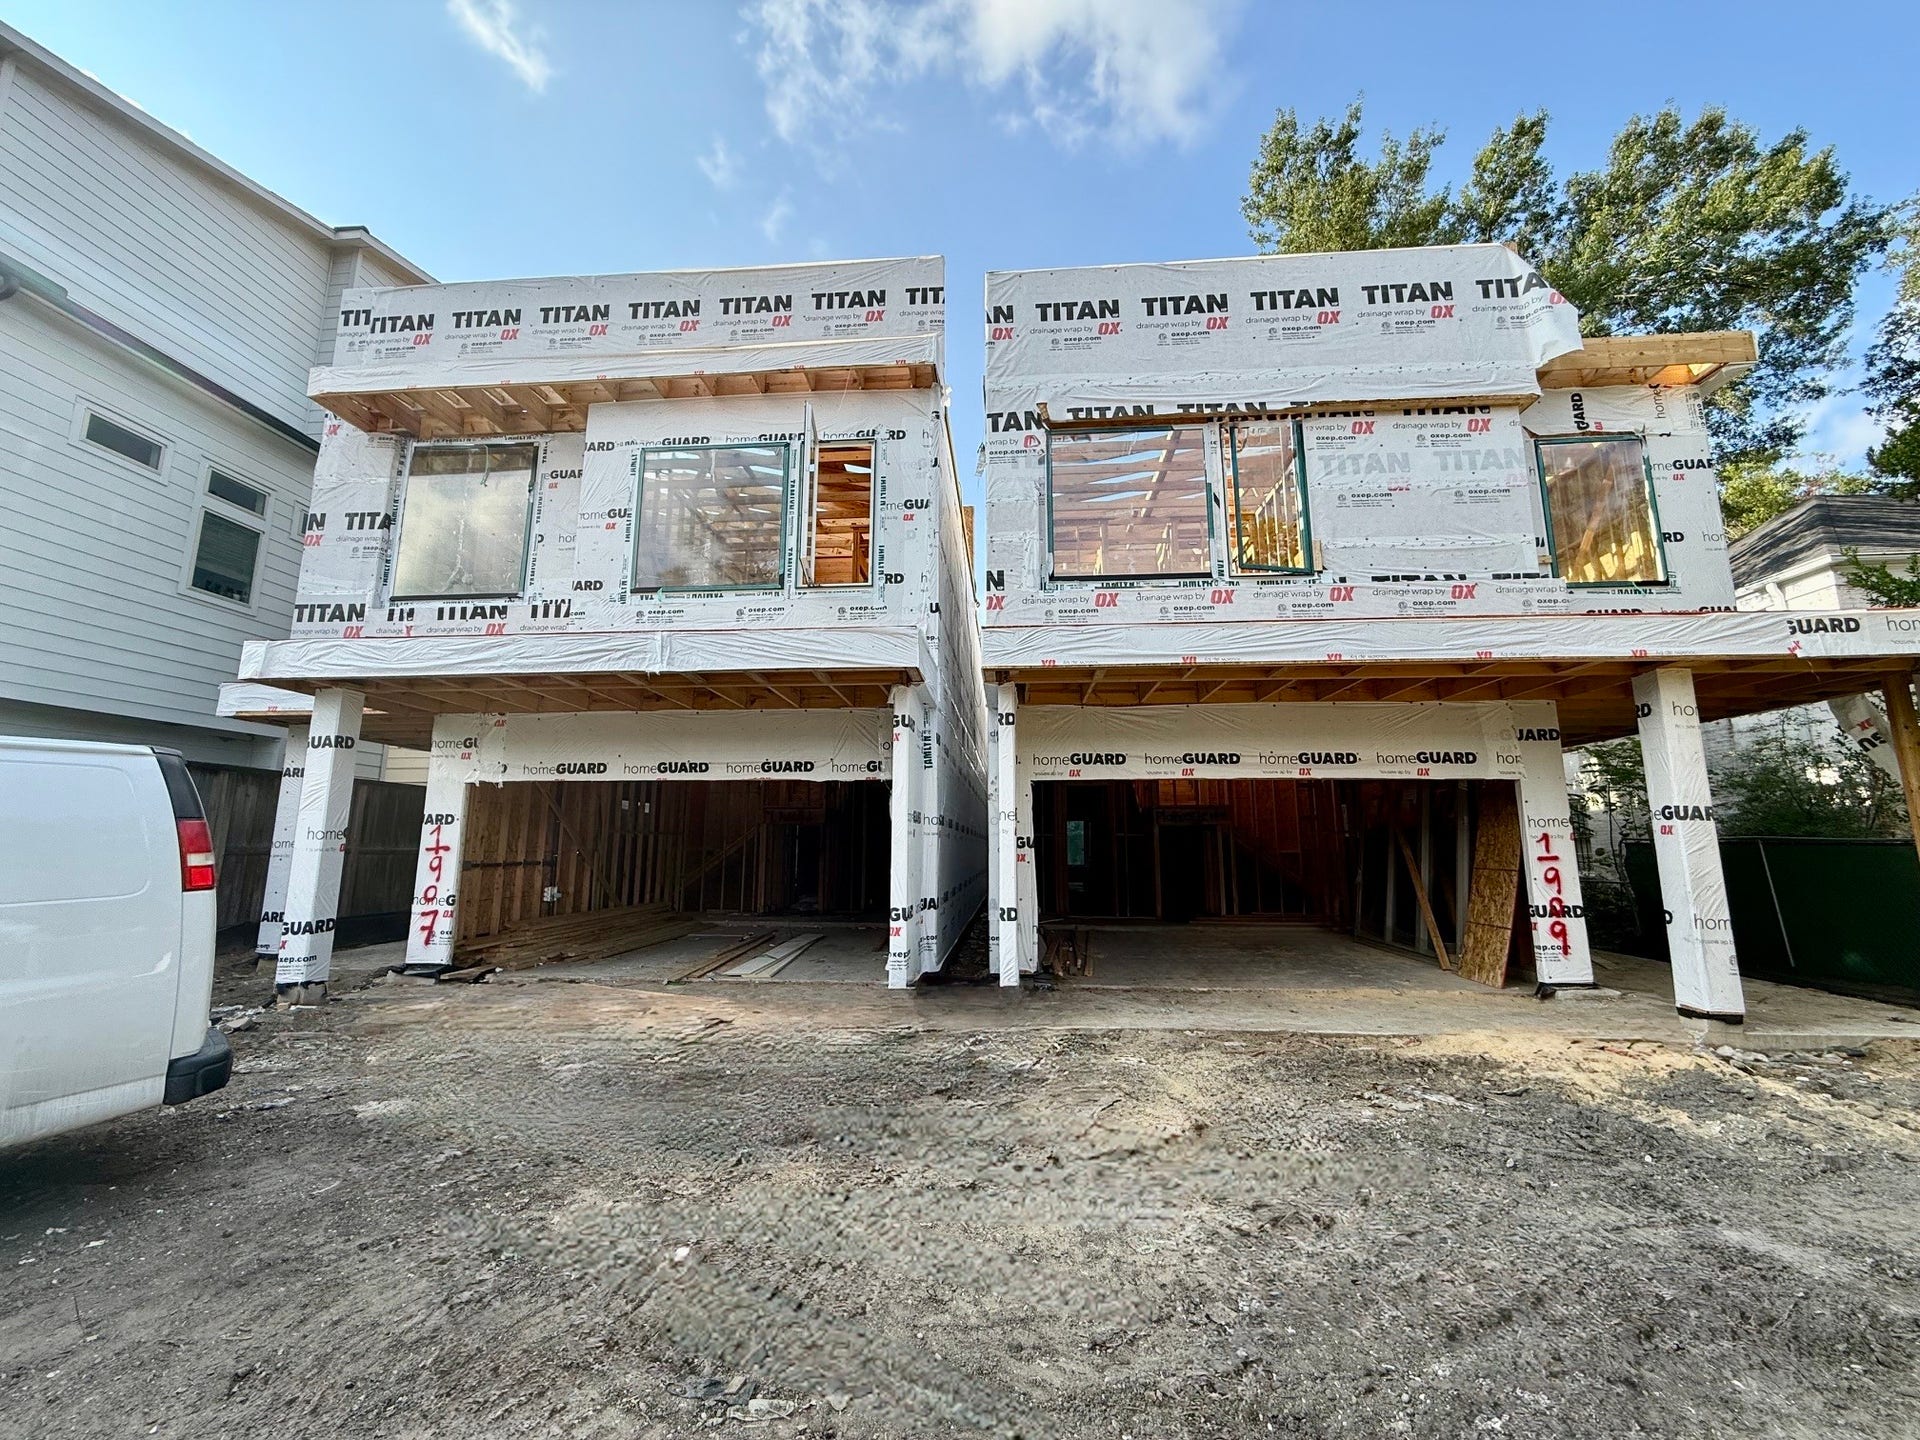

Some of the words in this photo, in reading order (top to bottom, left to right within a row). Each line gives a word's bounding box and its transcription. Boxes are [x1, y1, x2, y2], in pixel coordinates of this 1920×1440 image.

[811, 290, 886, 310] TITAN
[905, 286, 945, 305] TIT
[1250, 287, 1339, 311] TITAN
[1361, 281, 1453, 304] TITAN
[628, 299, 701, 320] TITAN
[719, 295, 792, 315] TITAN
[1035, 299, 1120, 322] TITAN
[1141, 293, 1229, 316] TITAN
[1430, 304, 1454, 318] OX
[452, 309, 522, 328] TITAN
[540, 304, 610, 324] TITAN
[771, 315, 792, 327] OX
[865, 310, 885, 322] OX
[986, 305, 1014, 324] AN
[1317, 310, 1340, 324] OX
[588, 324, 608, 336] OX
[679, 320, 699, 332] OX
[1097, 322, 1120, 335] OX
[1206, 316, 1229, 330] OX
[413, 333, 433, 345] OX
[500, 328, 520, 341] OX
[992, 327, 1014, 340] OX
[1351, 420, 1375, 435] OX
[1467, 418, 1491, 433] OX
[1094, 592, 1119, 608] OX
[1210, 589, 1235, 604] OX
[1329, 586, 1354, 602] OX
[1450, 584, 1476, 600] OX
[295, 603, 366, 622] TITAN
[1032, 752, 1127, 766] homeGUARD
[1145, 752, 1241, 765] homeGUARD
[1259, 751, 1358, 765] homeGUARD
[1376, 751, 1478, 765] homeGUARD
[523, 762, 608, 775] homeGUARD
[623, 761, 710, 774] homeGUARD
[726, 760, 815, 774] homeGUARD
